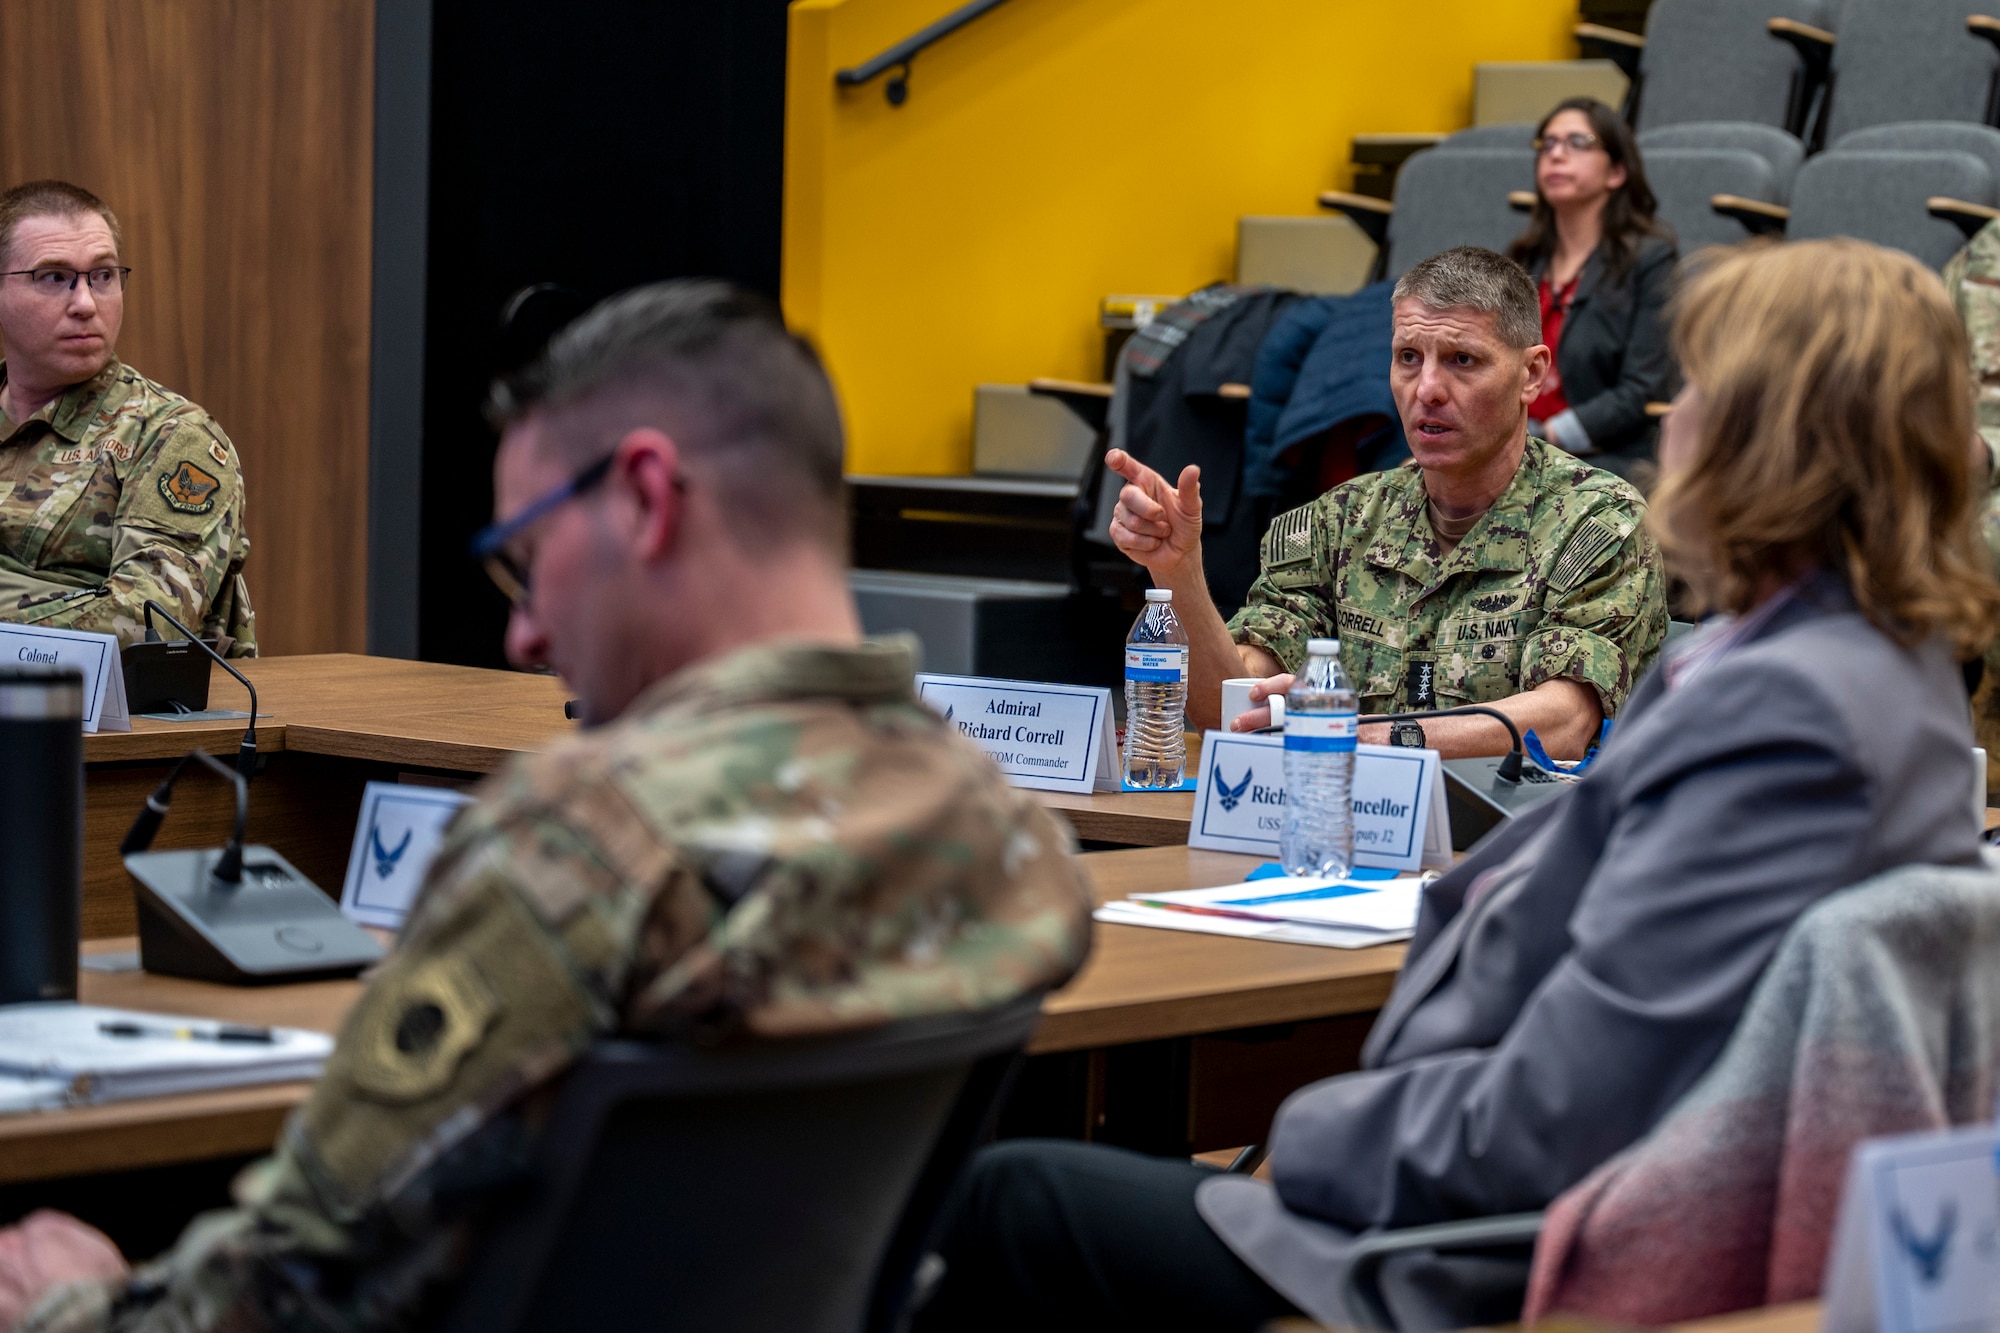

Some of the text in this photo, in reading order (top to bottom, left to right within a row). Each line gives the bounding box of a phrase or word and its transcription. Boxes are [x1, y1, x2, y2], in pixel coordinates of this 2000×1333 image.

[61, 449, 81, 462] U.S.
[1337, 609, 1384, 638] CORRELL
[1457, 617, 1520, 640] U.S. NAVY
[18, 646, 59, 665] Colonel
[985, 699, 1042, 717] Admiral
[958, 721, 1065, 746] Richard Correll
[1015, 753, 1070, 769] Commander
[1251, 784, 1410, 818] Rich ncellor
[1355, 829, 1378, 845] puty
[1381, 829, 1395, 844] J2
